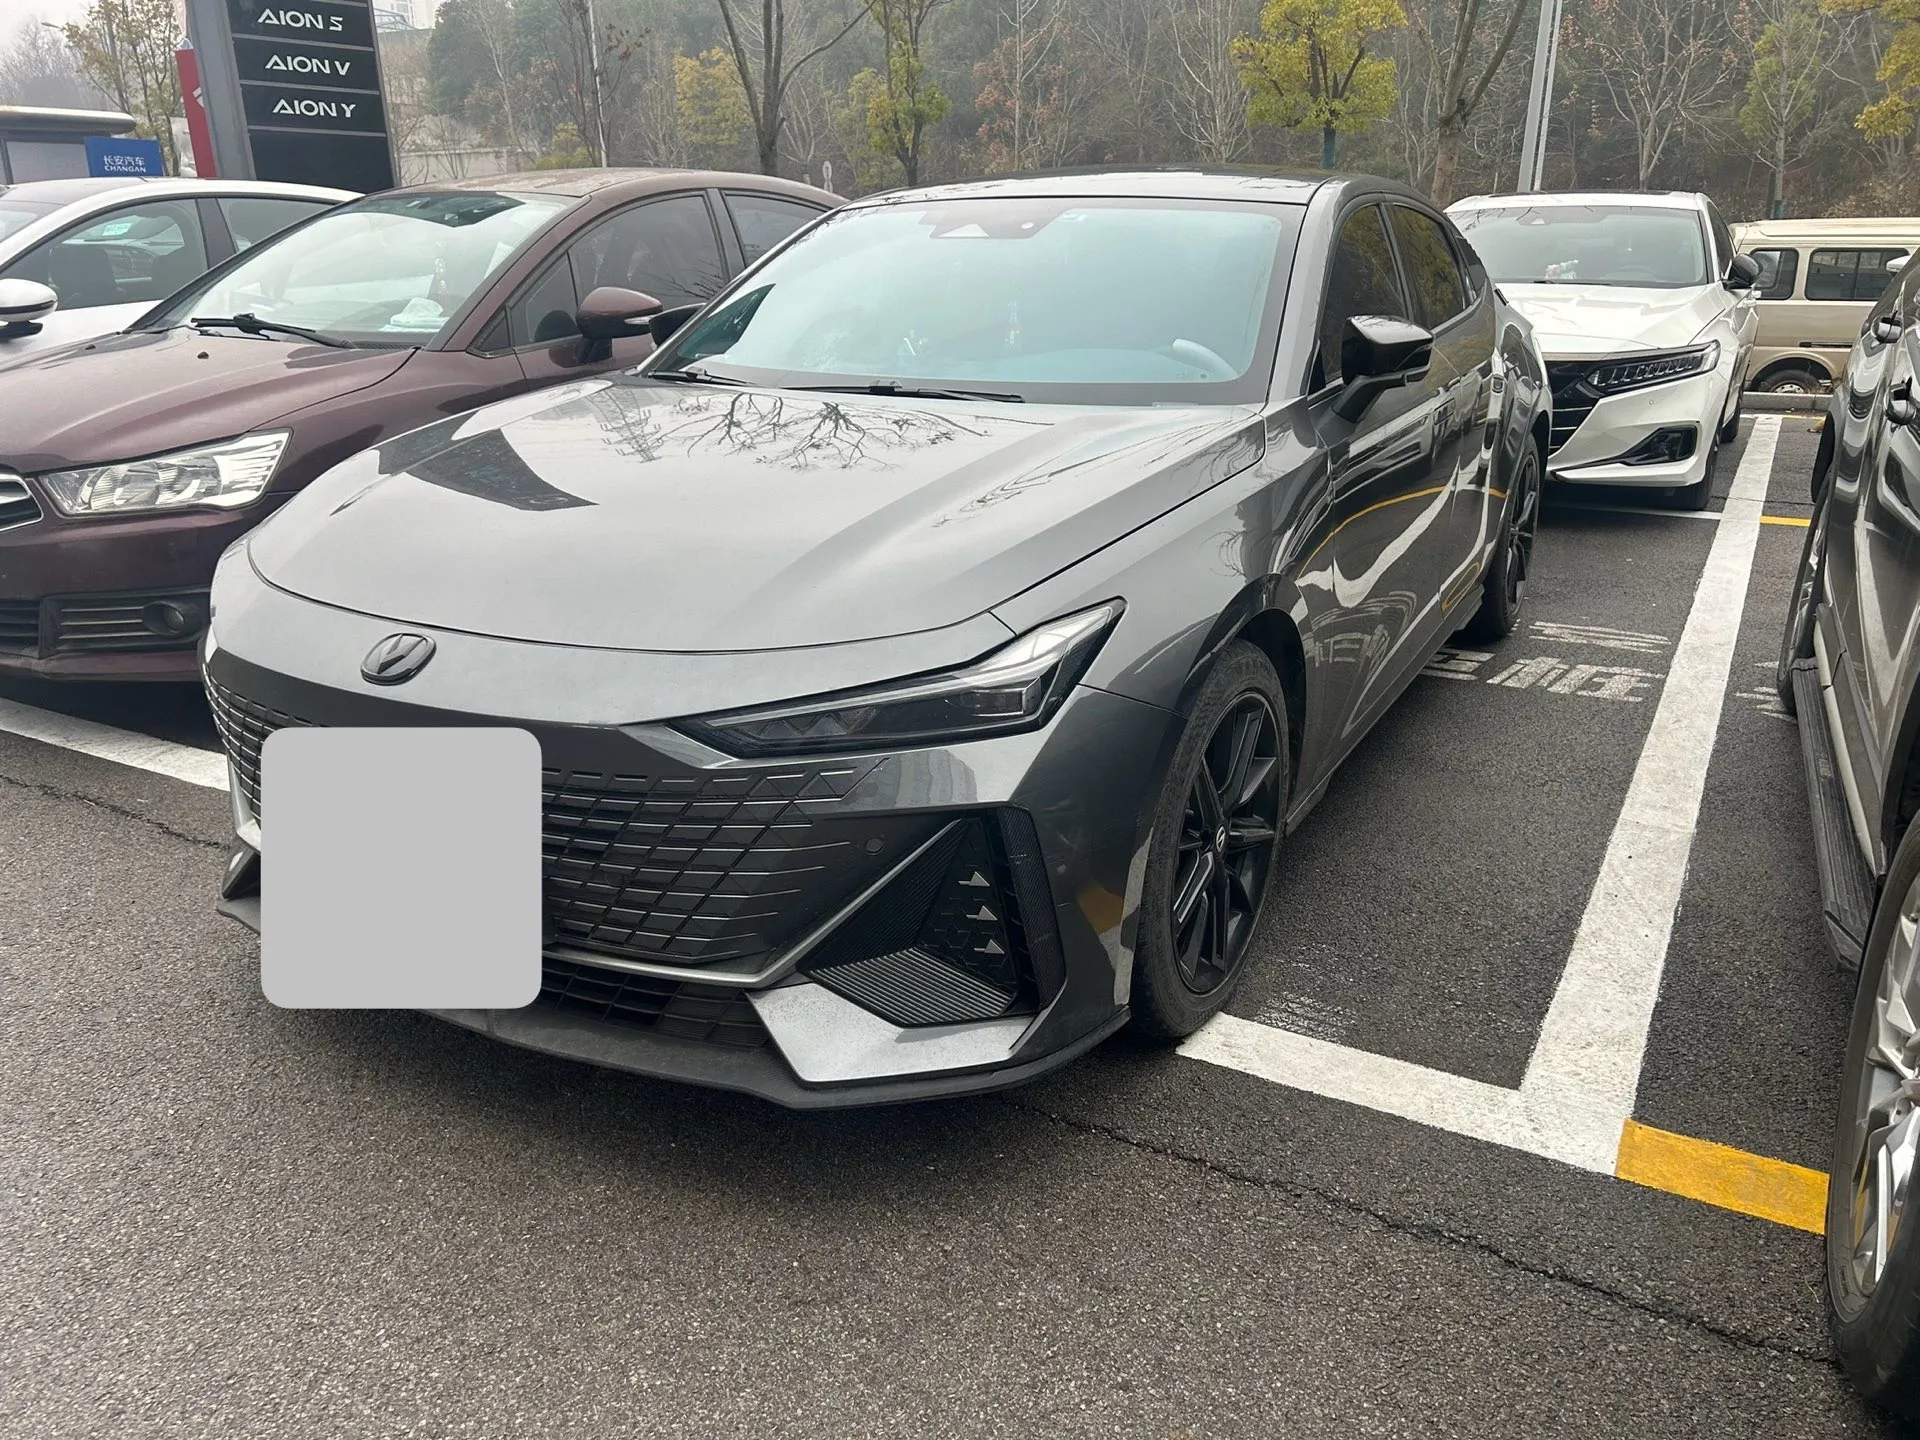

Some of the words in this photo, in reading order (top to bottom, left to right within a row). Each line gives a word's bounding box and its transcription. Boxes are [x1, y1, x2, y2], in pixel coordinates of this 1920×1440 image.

[257, 8, 324, 30] AION
[329, 15, 344, 32] S
[265, 54, 331, 74] AION
[334, 60, 351, 76] V
[272, 98, 338, 117] AION
[340, 103, 356, 118] Y
[103, 155, 145, 166] 长安汽车
[104, 165, 146, 173] CHANGAN
